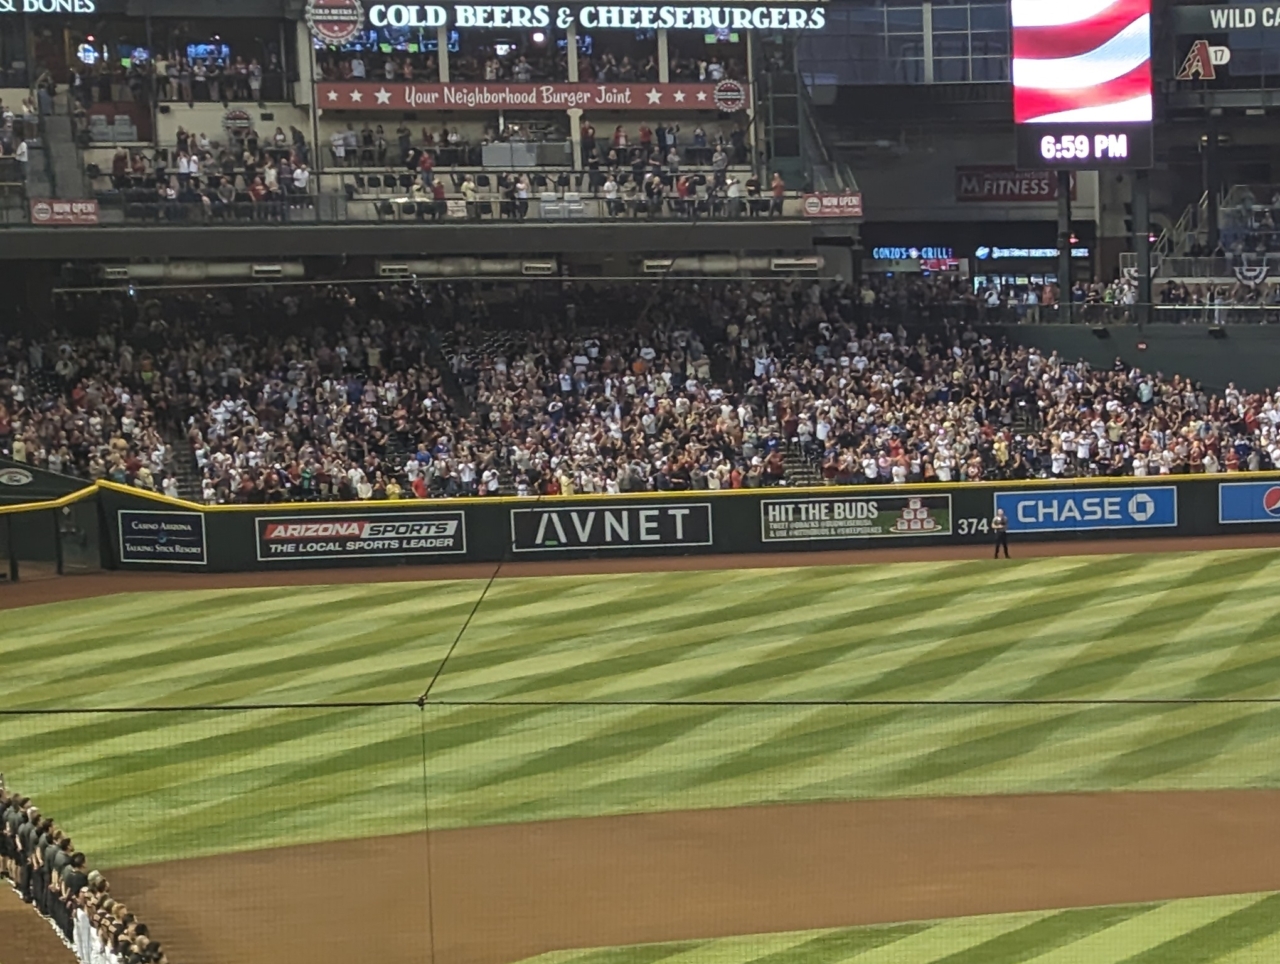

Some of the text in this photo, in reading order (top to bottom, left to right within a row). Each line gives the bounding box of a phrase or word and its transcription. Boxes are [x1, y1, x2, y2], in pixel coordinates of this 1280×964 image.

[369, 4, 826, 30] COLD BEERS & CHEESEBURGERS
[1210, 8, 1257, 29] WILD
[1213, 50, 1224, 61] 17
[404, 86, 632, 107] Your Neighborhood Burger Joint
[1041, 134, 1128, 159] 6:59 PM
[984, 179, 1050, 195] FITNESS
[873, 247, 948, 259] GONZO'S GRILL
[768, 501, 879, 522] HIT THE BUDS
[1017, 497, 1122, 523] CHASE
[131, 521, 192, 531] CASINO ARIZONA
[270, 522, 449, 537] ARIZONA SPORTS
[535, 508, 690, 545] AVNET
[957, 518, 990, 534] 374
[125, 543, 201, 554] TALKING STICK RESORT
[269, 538, 454, 553] THE LOCAL SPORTS LEADER
